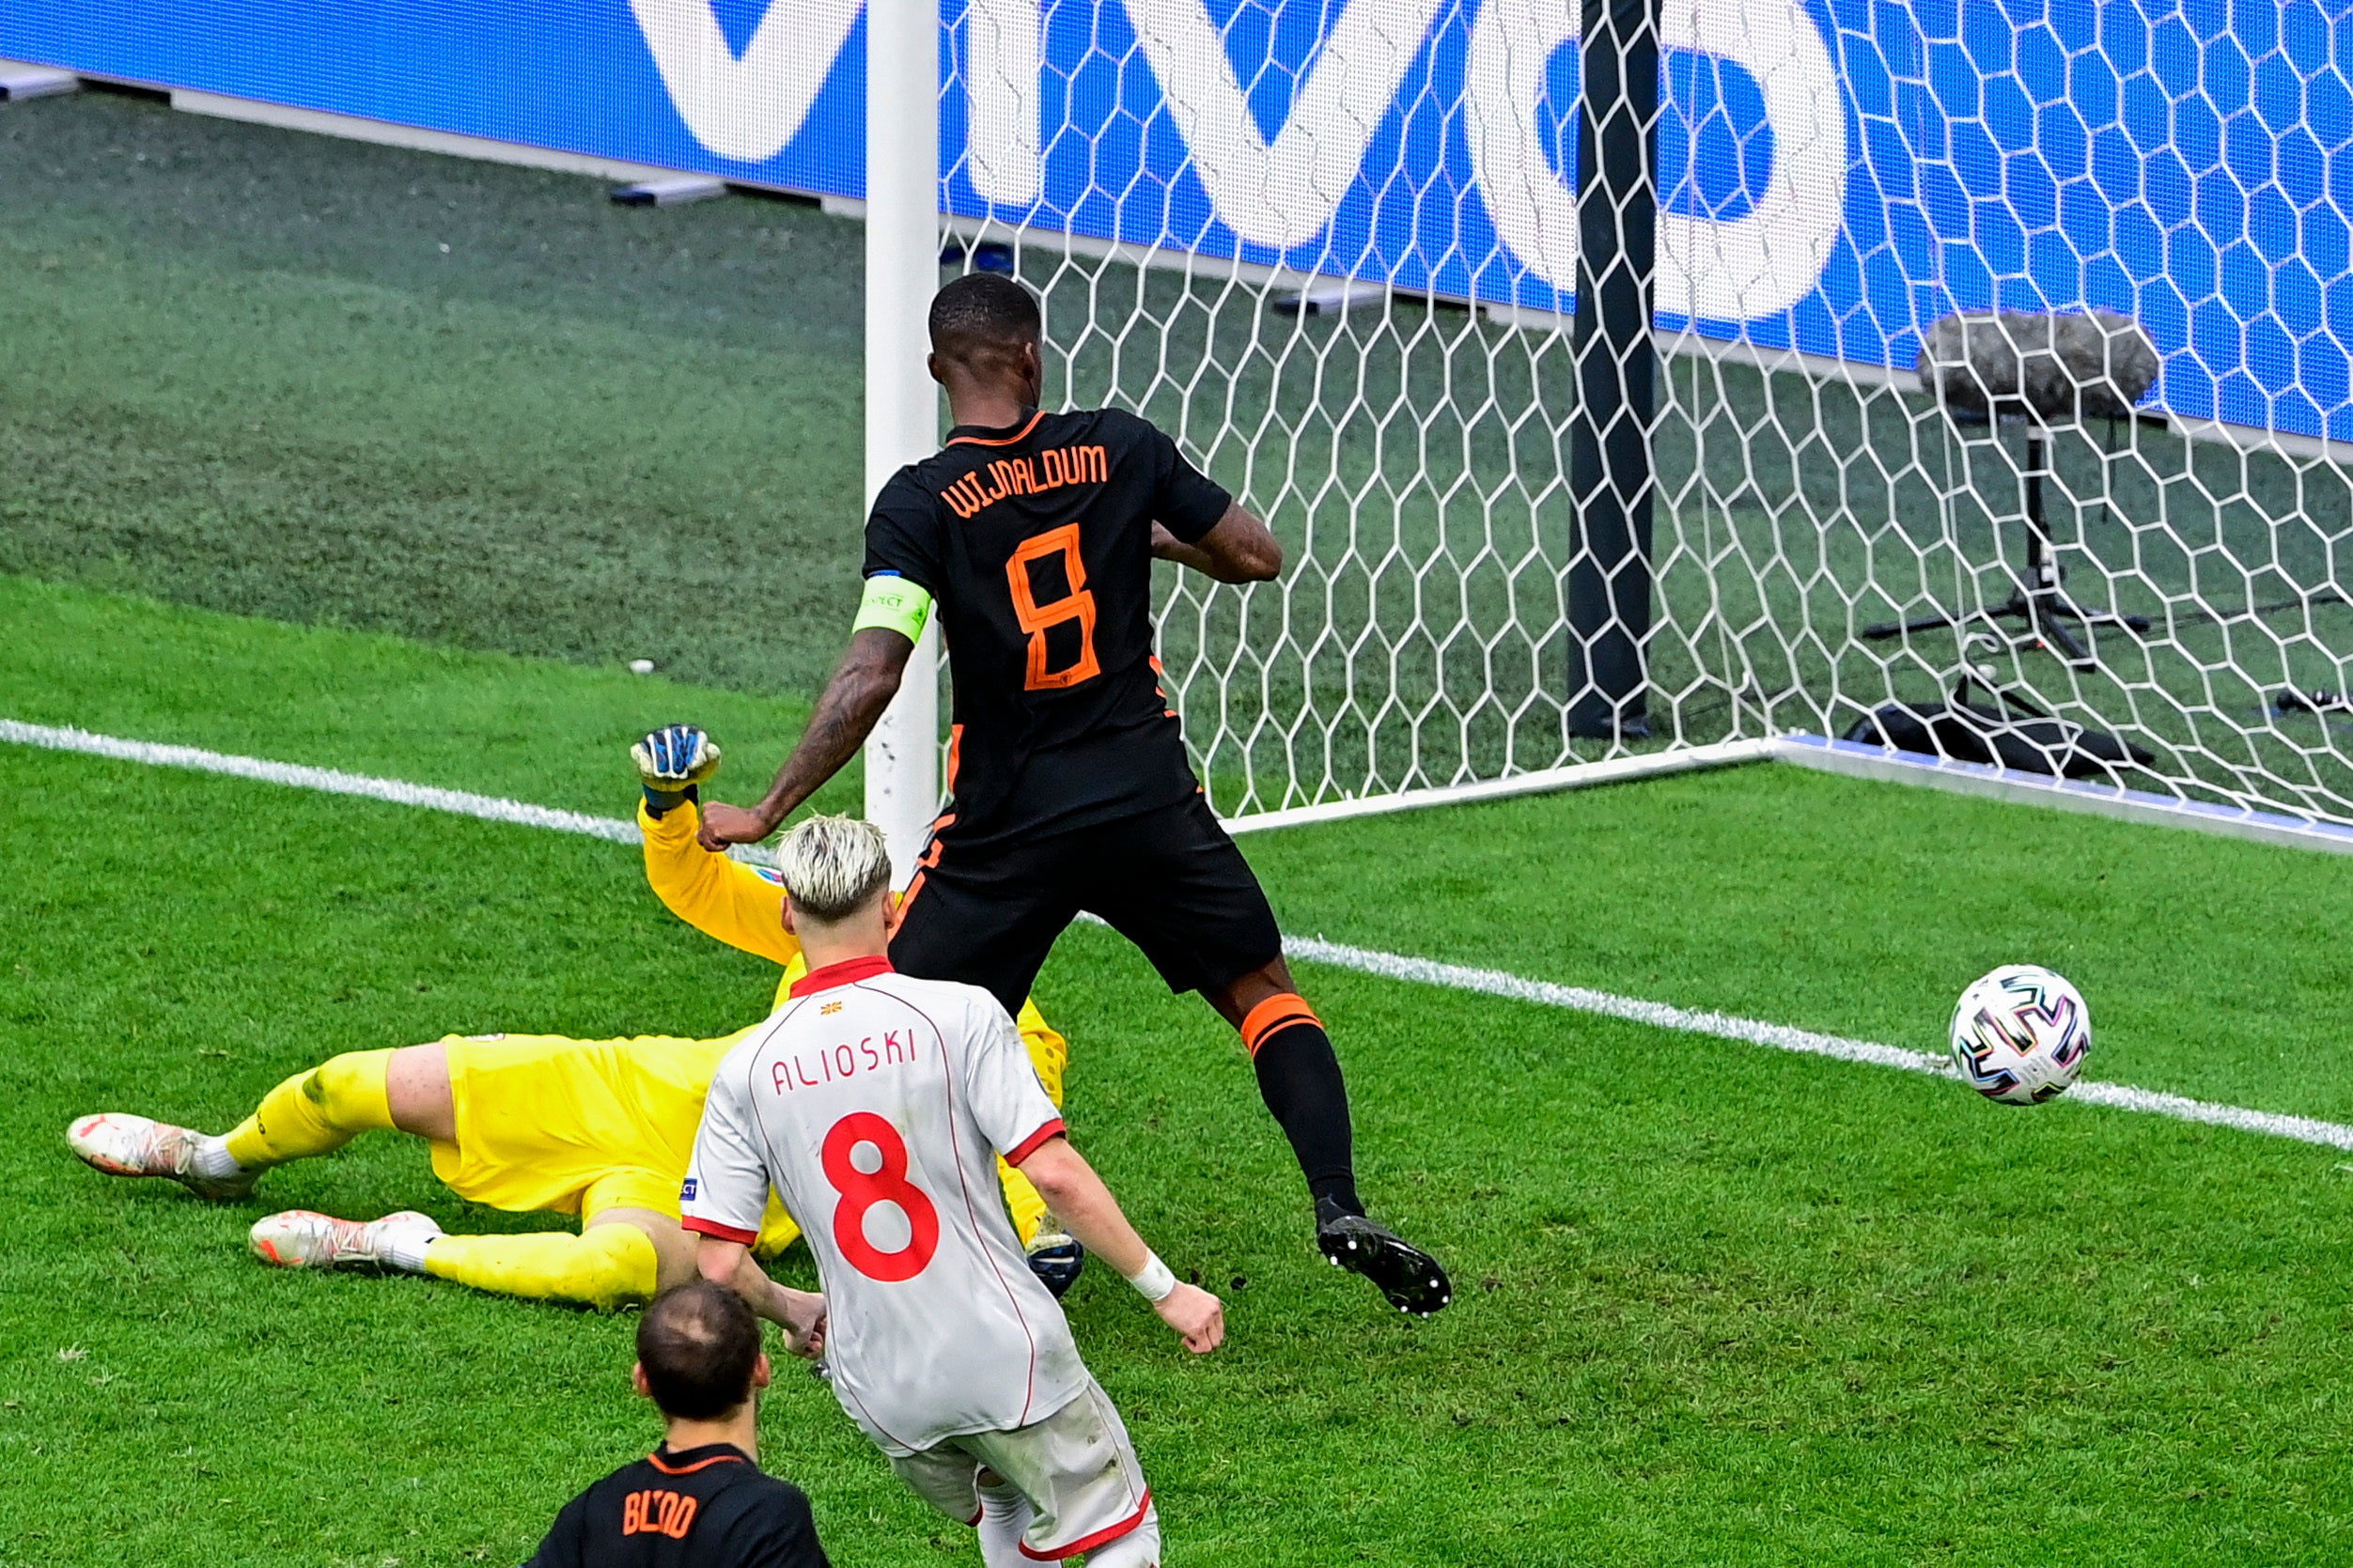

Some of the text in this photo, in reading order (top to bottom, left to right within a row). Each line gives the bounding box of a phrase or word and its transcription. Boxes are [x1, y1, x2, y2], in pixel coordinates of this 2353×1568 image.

[941, 444, 1109, 519] WIJNALDUM
[1005, 522, 1101, 691] 8
[771, 1029, 917, 1095] ALIOSKI
[820, 1111, 941, 1282] 8
[623, 1489, 697, 1539] BLND
